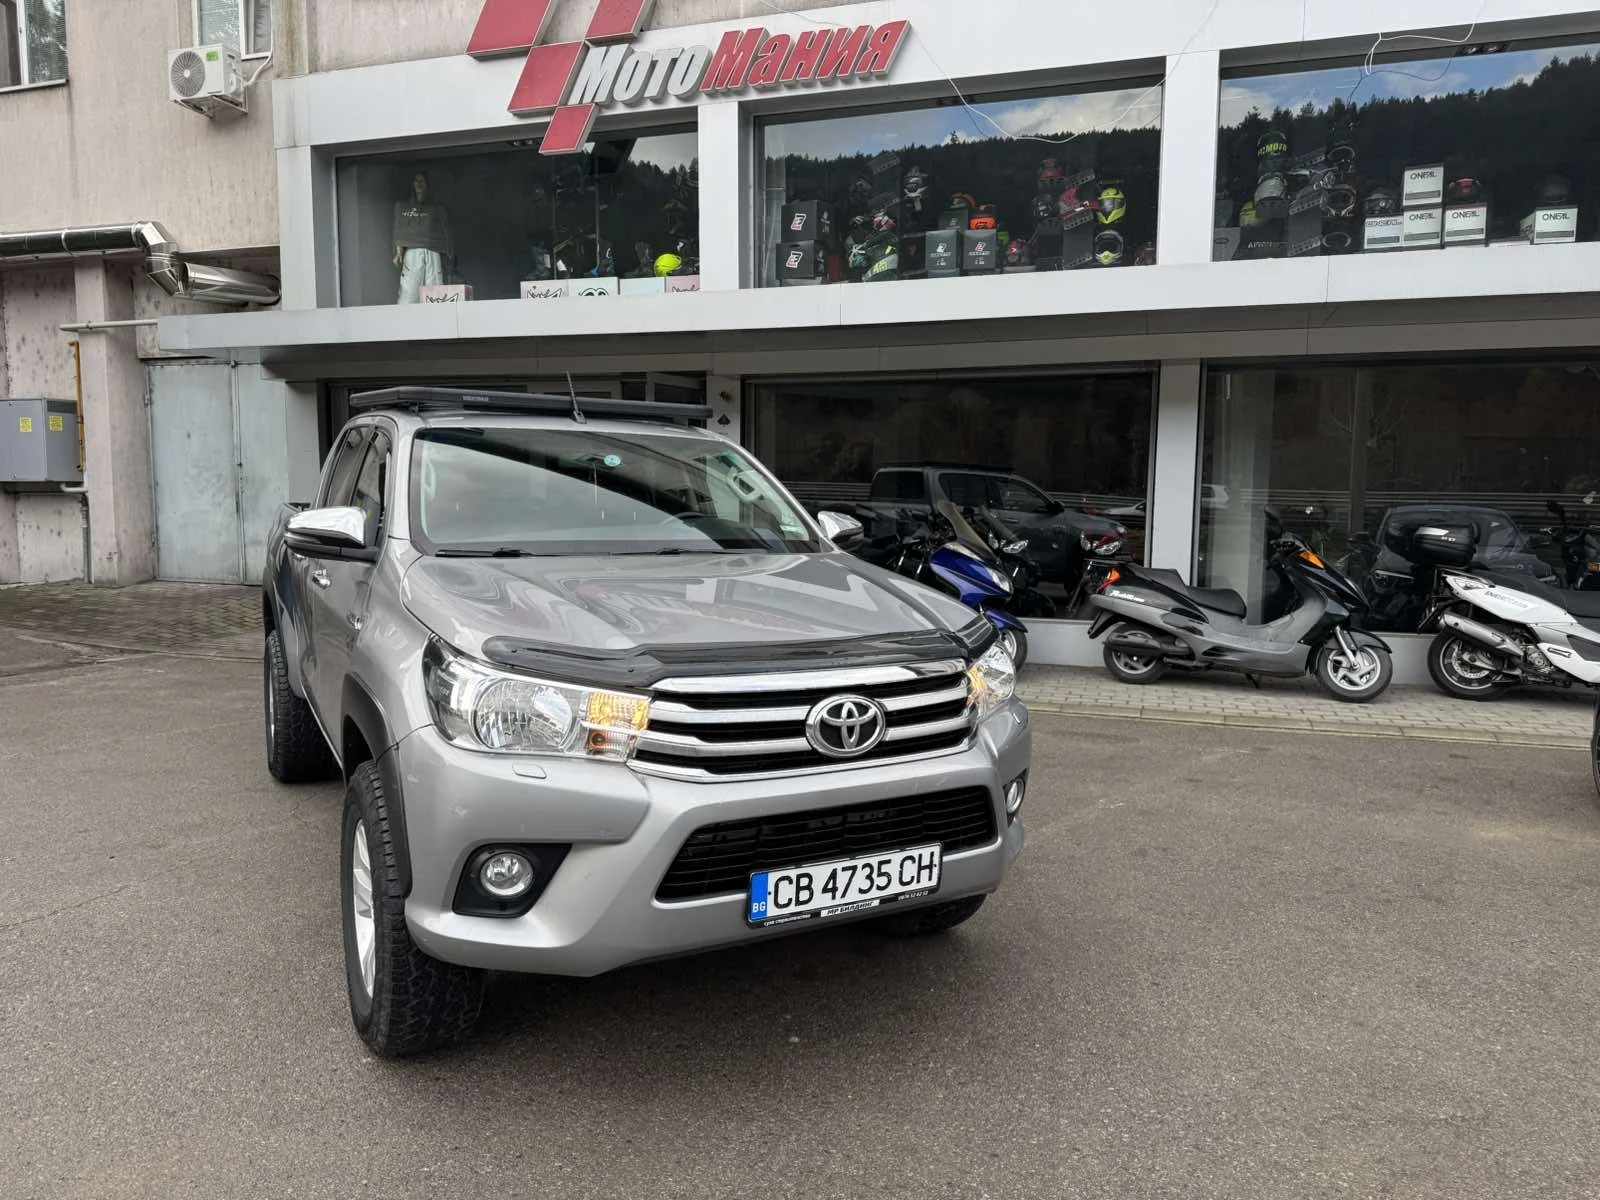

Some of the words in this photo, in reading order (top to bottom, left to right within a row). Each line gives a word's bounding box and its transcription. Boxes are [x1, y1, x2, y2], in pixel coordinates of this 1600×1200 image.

[773, 872, 815, 910] CB
[821, 858, 893, 901] 4735
[898, 850, 936, 888] CH
[752, 900, 767, 914] BG
